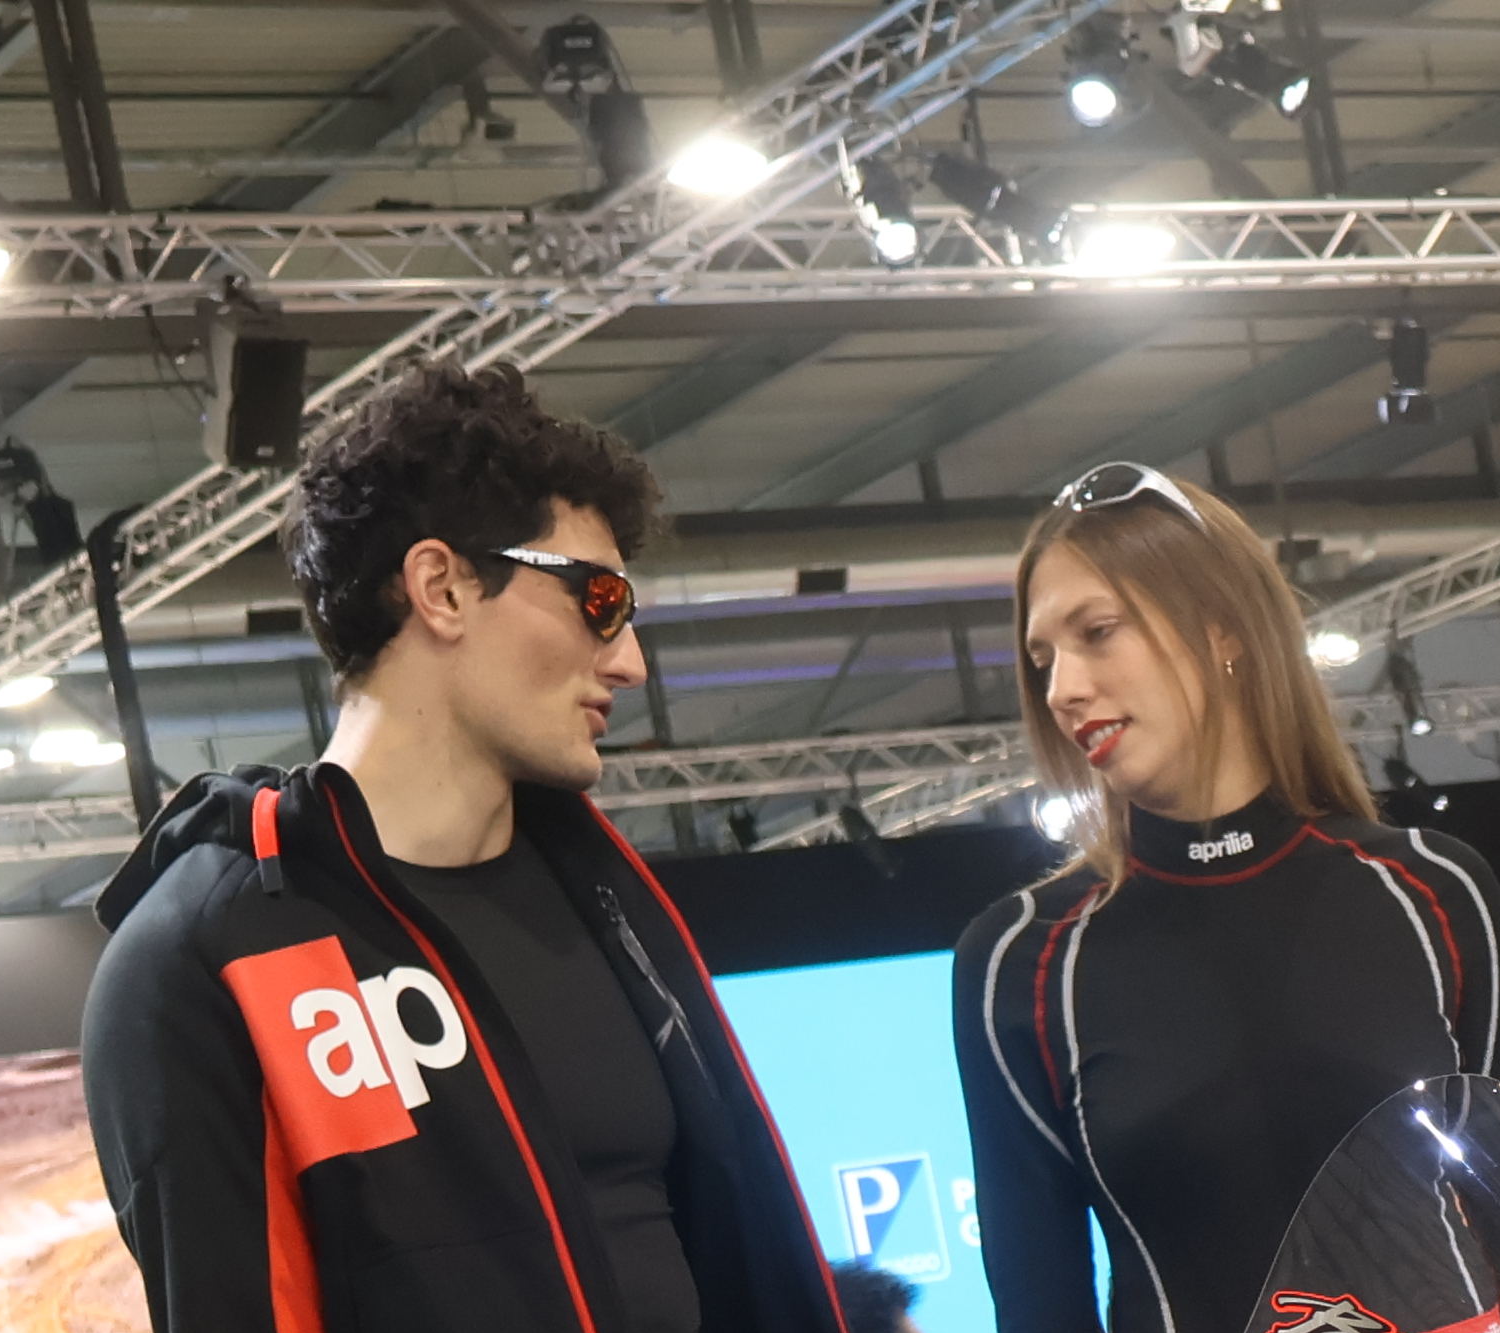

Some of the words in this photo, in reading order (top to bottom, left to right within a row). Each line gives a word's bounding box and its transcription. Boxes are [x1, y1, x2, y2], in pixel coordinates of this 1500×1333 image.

[1188, 829, 1253, 865] aprilia
[289, 962, 469, 1110] ap
[843, 1167, 900, 1256] P
